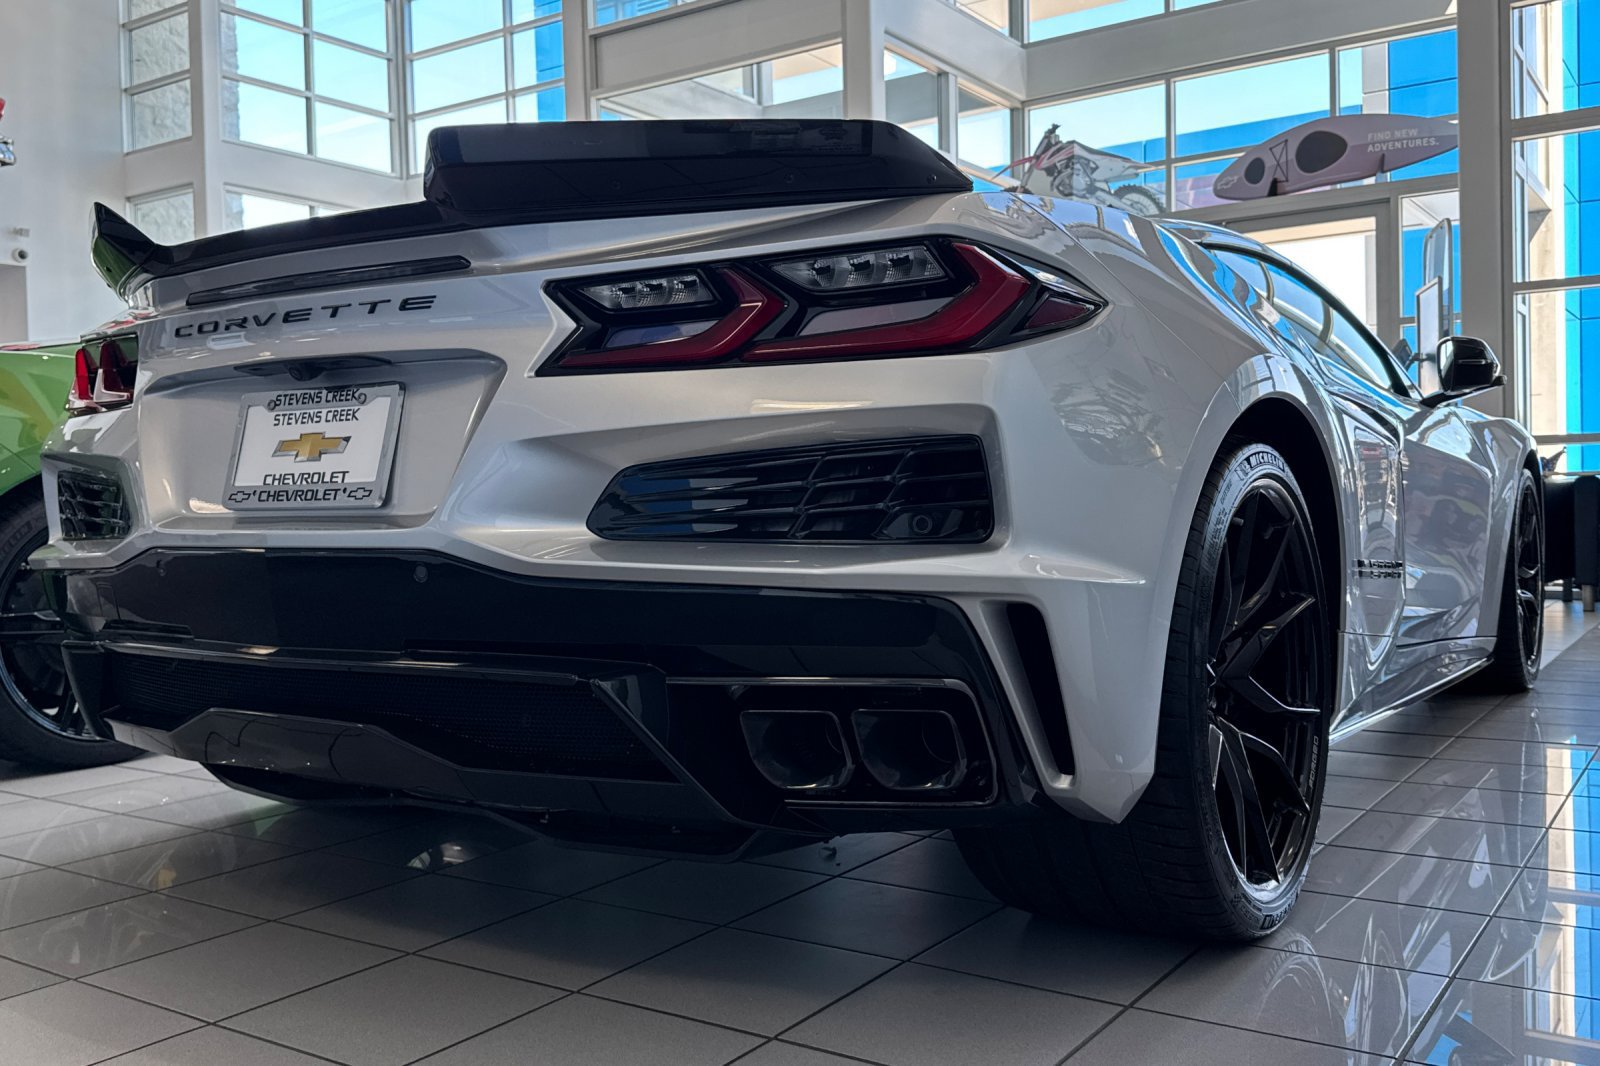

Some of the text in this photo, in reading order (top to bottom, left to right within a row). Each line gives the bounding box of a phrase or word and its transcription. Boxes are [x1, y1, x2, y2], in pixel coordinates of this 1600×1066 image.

[1367, 128, 1418, 142] FIND NEW
[1367, 138, 1440, 153] ADVENTURES.
[174, 295, 438, 338] CORVETTE
[275, 388, 360, 407] STEVENS CREEK
[273, 407, 361, 427] STEVENS CREEK
[1249, 451, 1286, 472] MICHELIN
[263, 470, 350, 486] CHEVROLET
